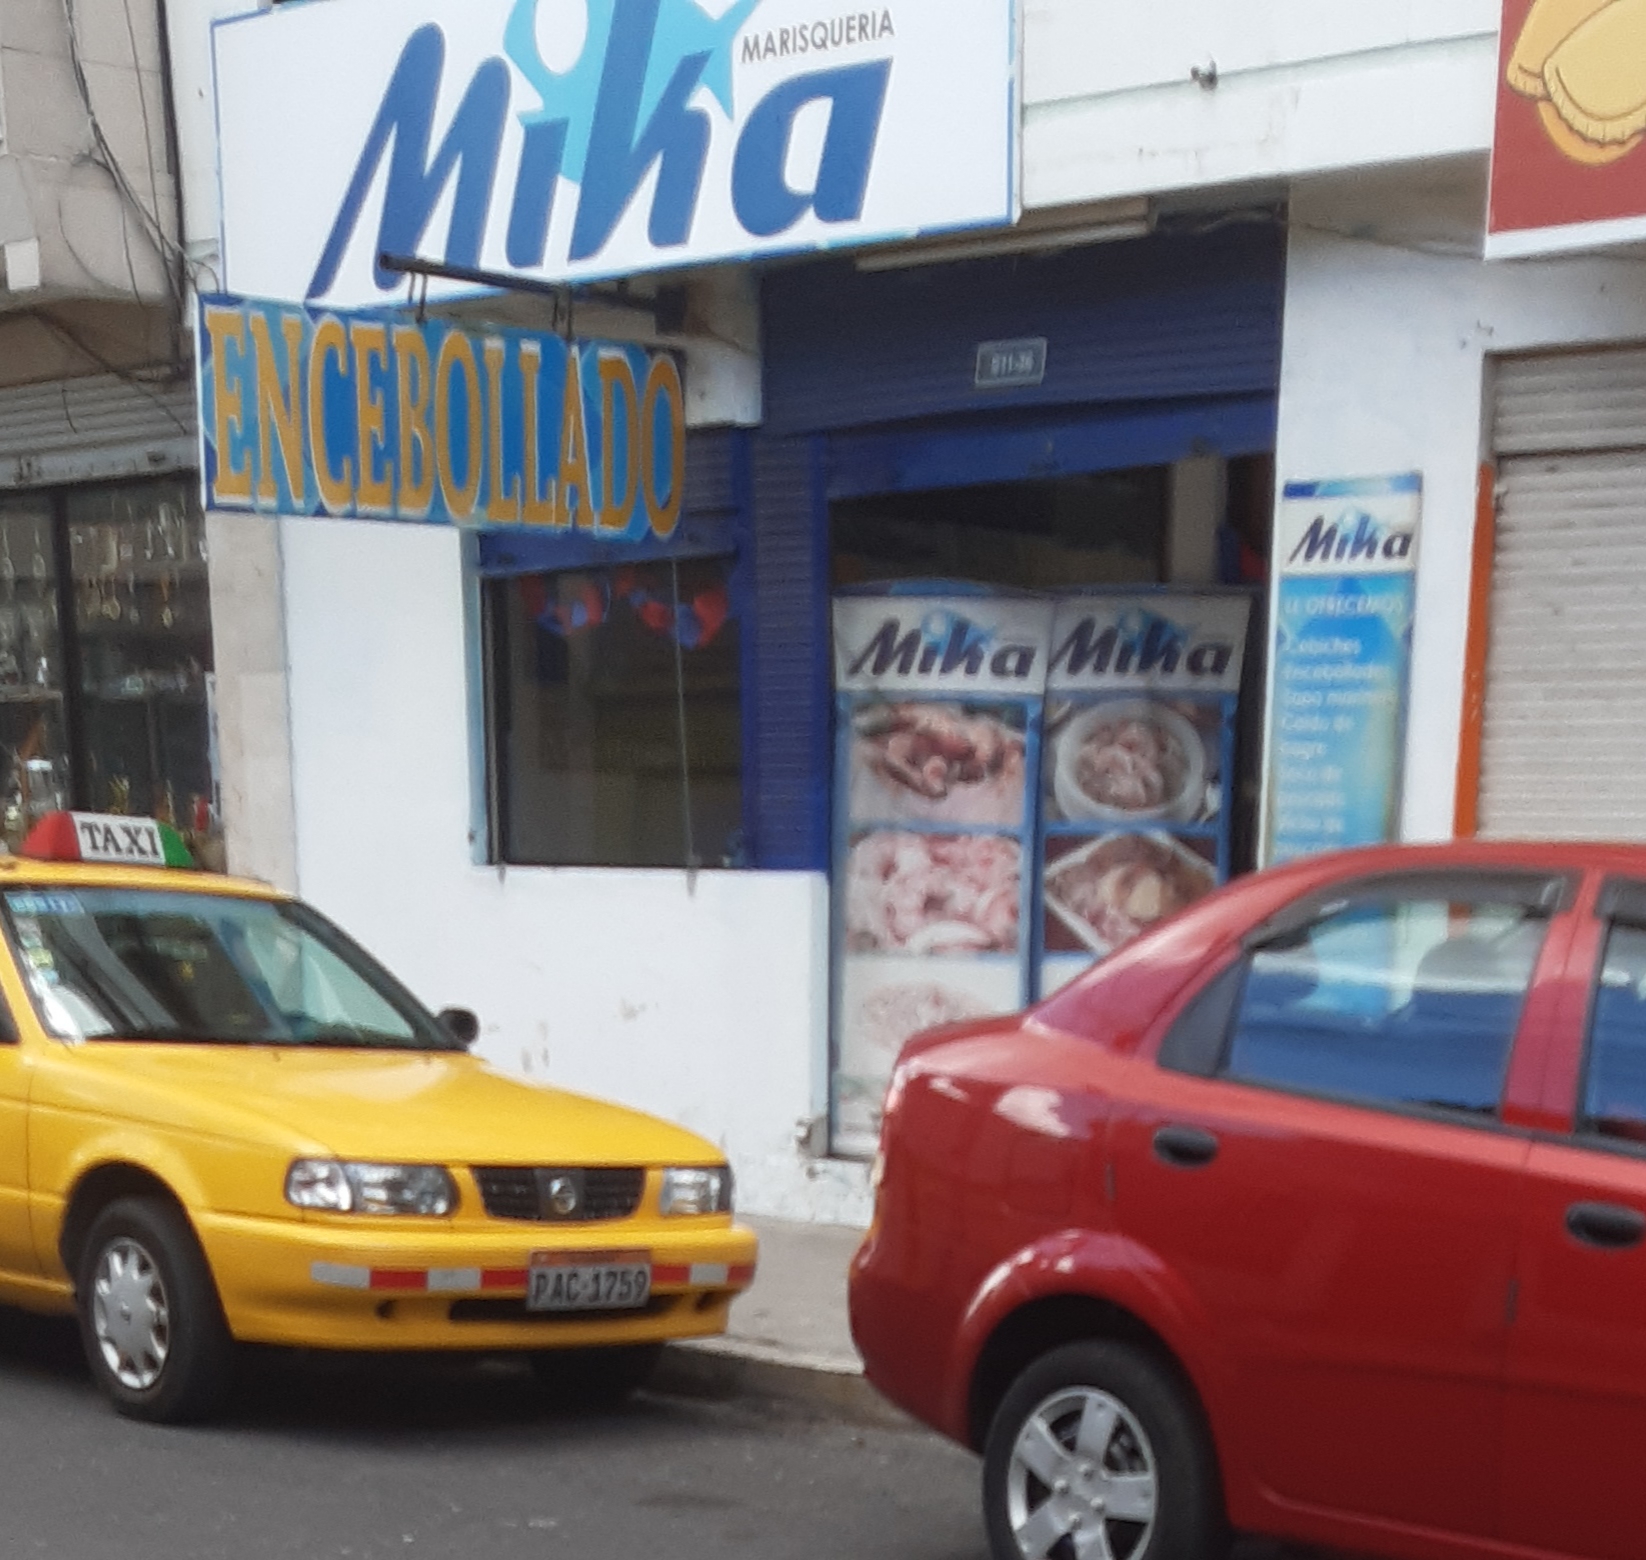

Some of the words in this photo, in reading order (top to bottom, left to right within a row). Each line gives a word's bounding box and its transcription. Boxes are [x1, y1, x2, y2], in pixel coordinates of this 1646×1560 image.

[741, 8, 894, 63] MARISQUERIA
[204, 303, 686, 541] ENCEBOLLADO
[80, 820, 160, 857] TAXI
[533, 1269, 648, 1304] PAC-1759
